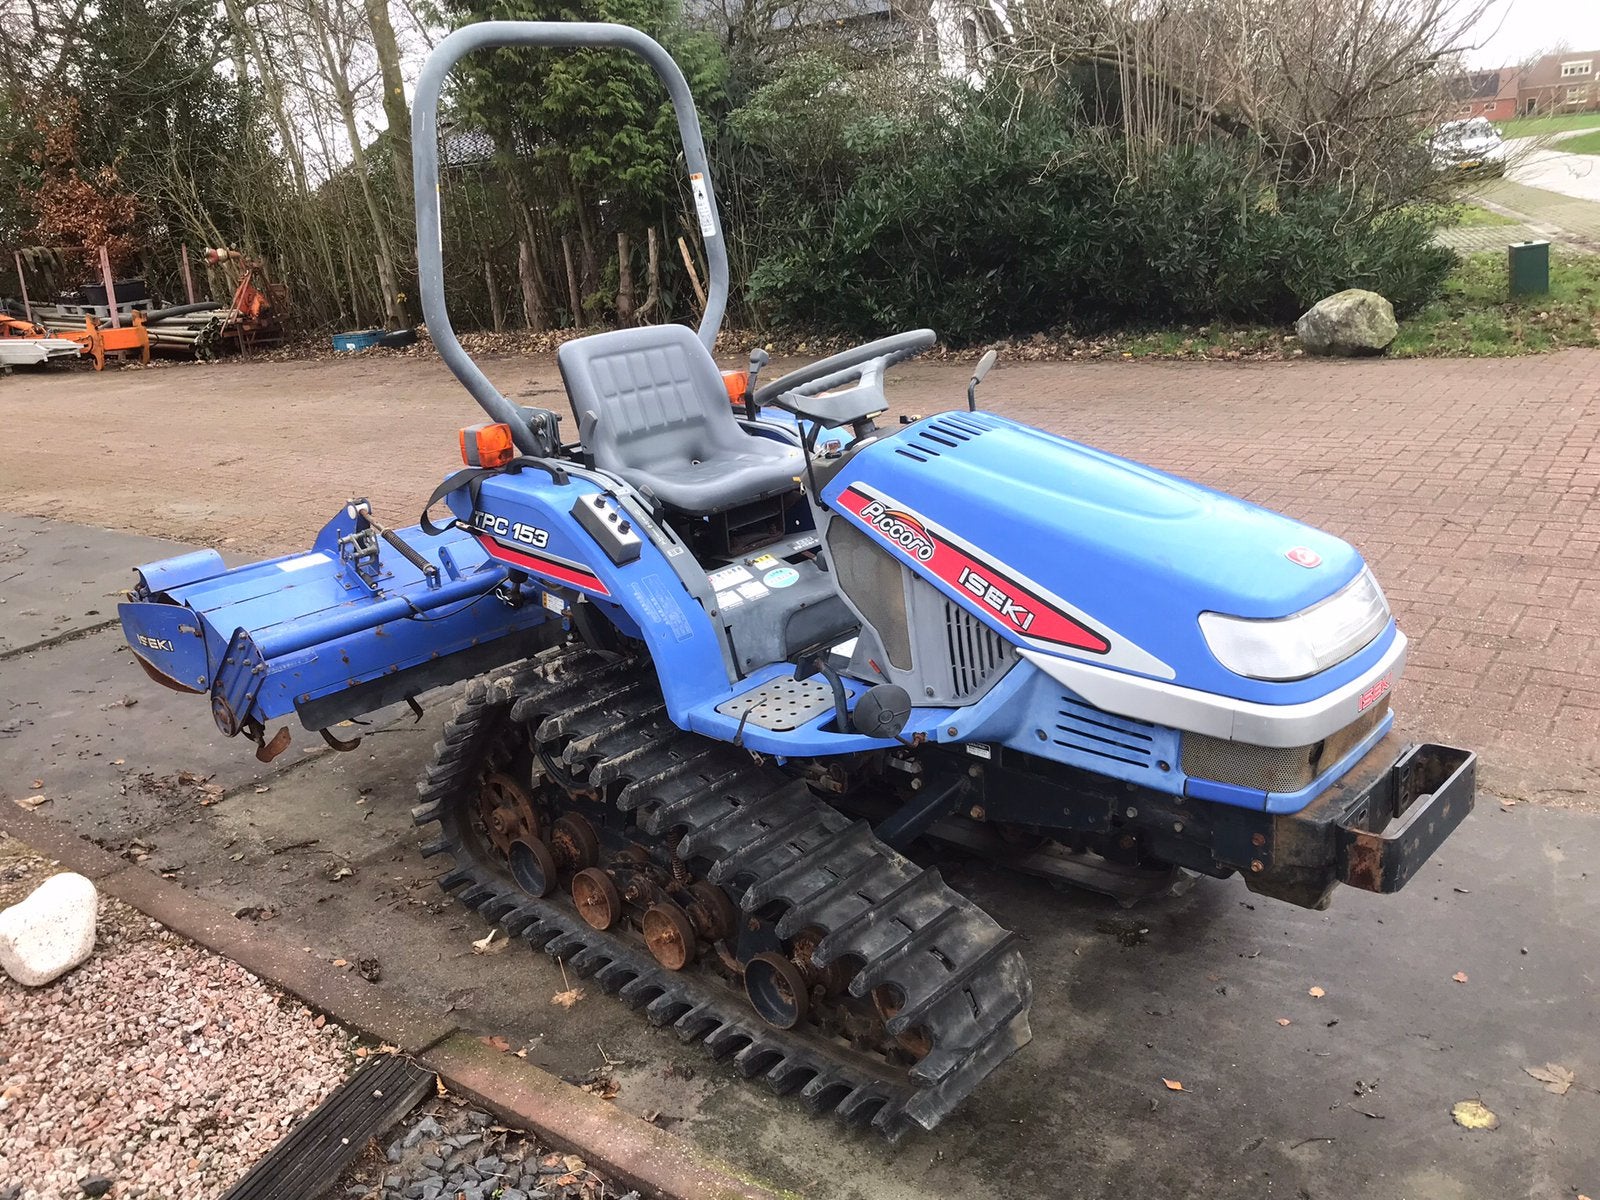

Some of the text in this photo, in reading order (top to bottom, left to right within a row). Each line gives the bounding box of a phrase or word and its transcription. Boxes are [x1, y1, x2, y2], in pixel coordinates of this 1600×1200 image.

[474, 510, 549, 549] TPC 153
[957, 566, 1036, 632] ISEKI
[136, 633, 175, 652] ISEKI
[1358, 671, 1393, 712] ISEKI
